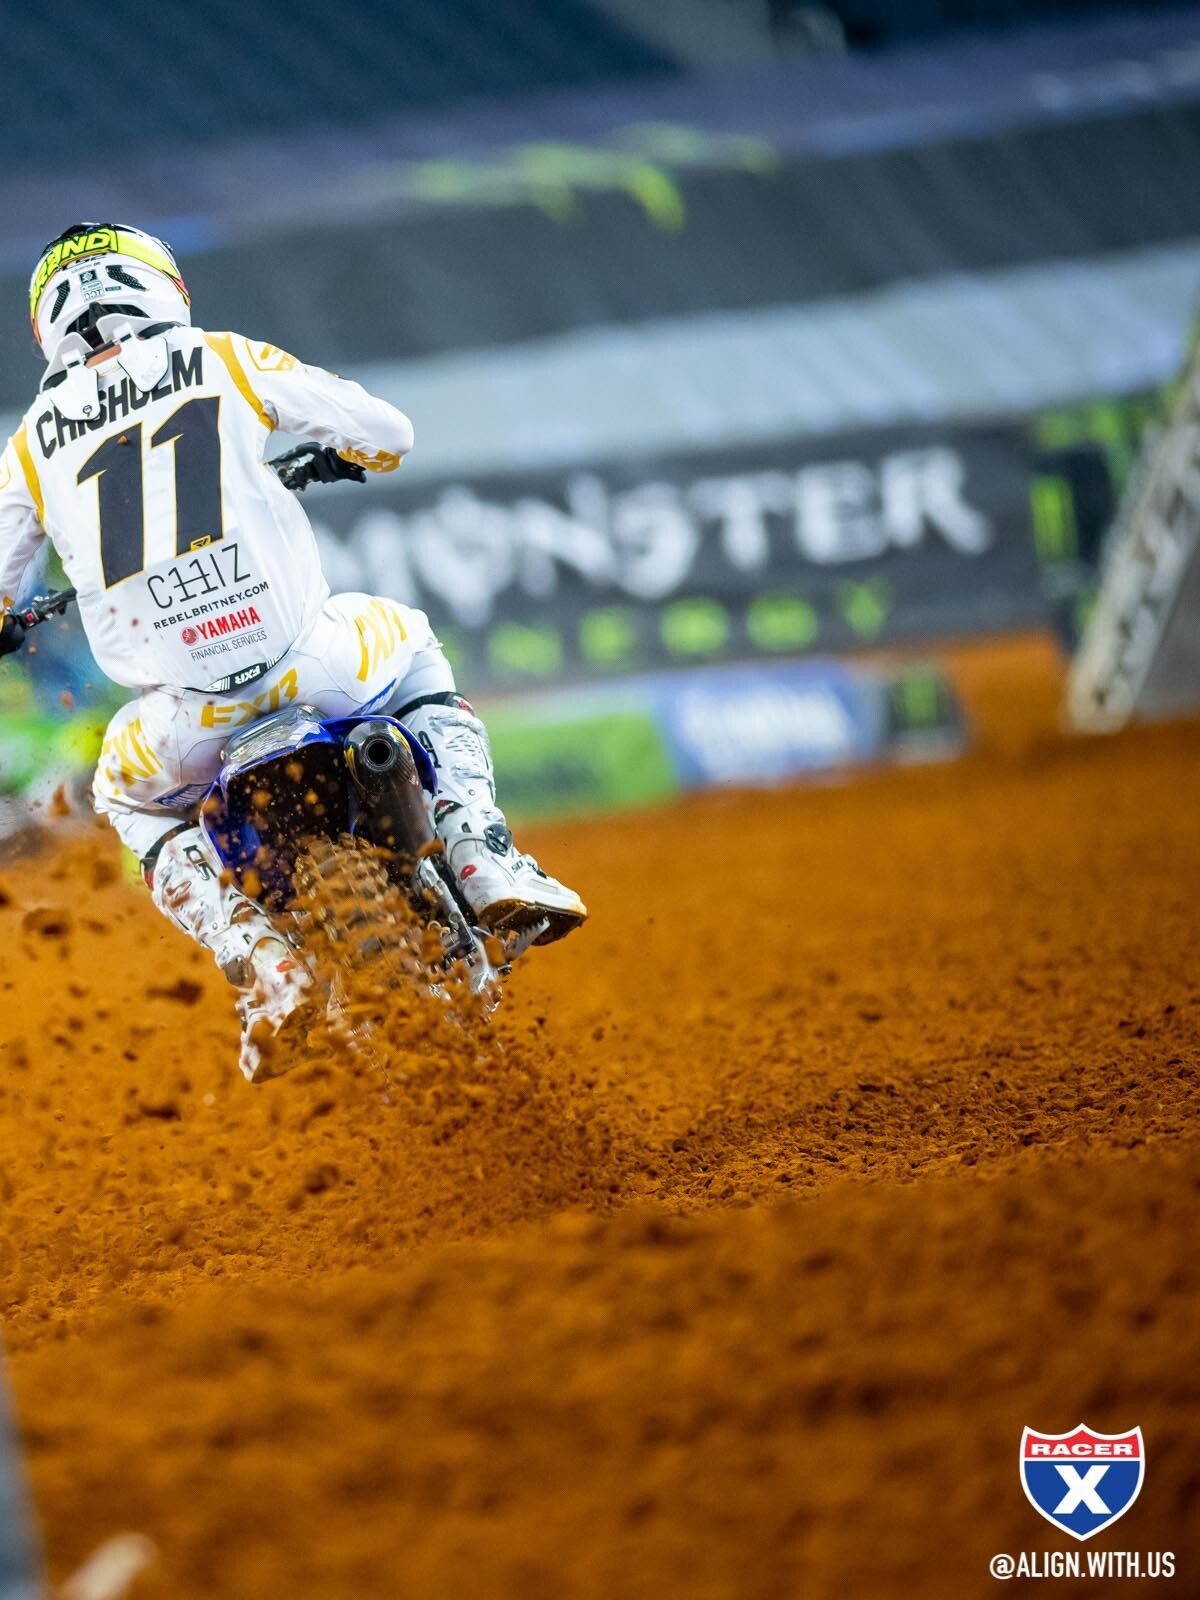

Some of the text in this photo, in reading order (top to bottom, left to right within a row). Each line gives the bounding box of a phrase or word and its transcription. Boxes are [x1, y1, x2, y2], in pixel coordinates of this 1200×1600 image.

[76, 394, 224, 590] 11
[153, 581, 269, 630] REBELBRITNEY.COM
[195, 606, 261, 640] YAMAHA
[191, 630, 268, 662] FINANCIAL SERVICES
[234, 665, 262, 685] FXR
[200, 667, 299, 729] FXR
